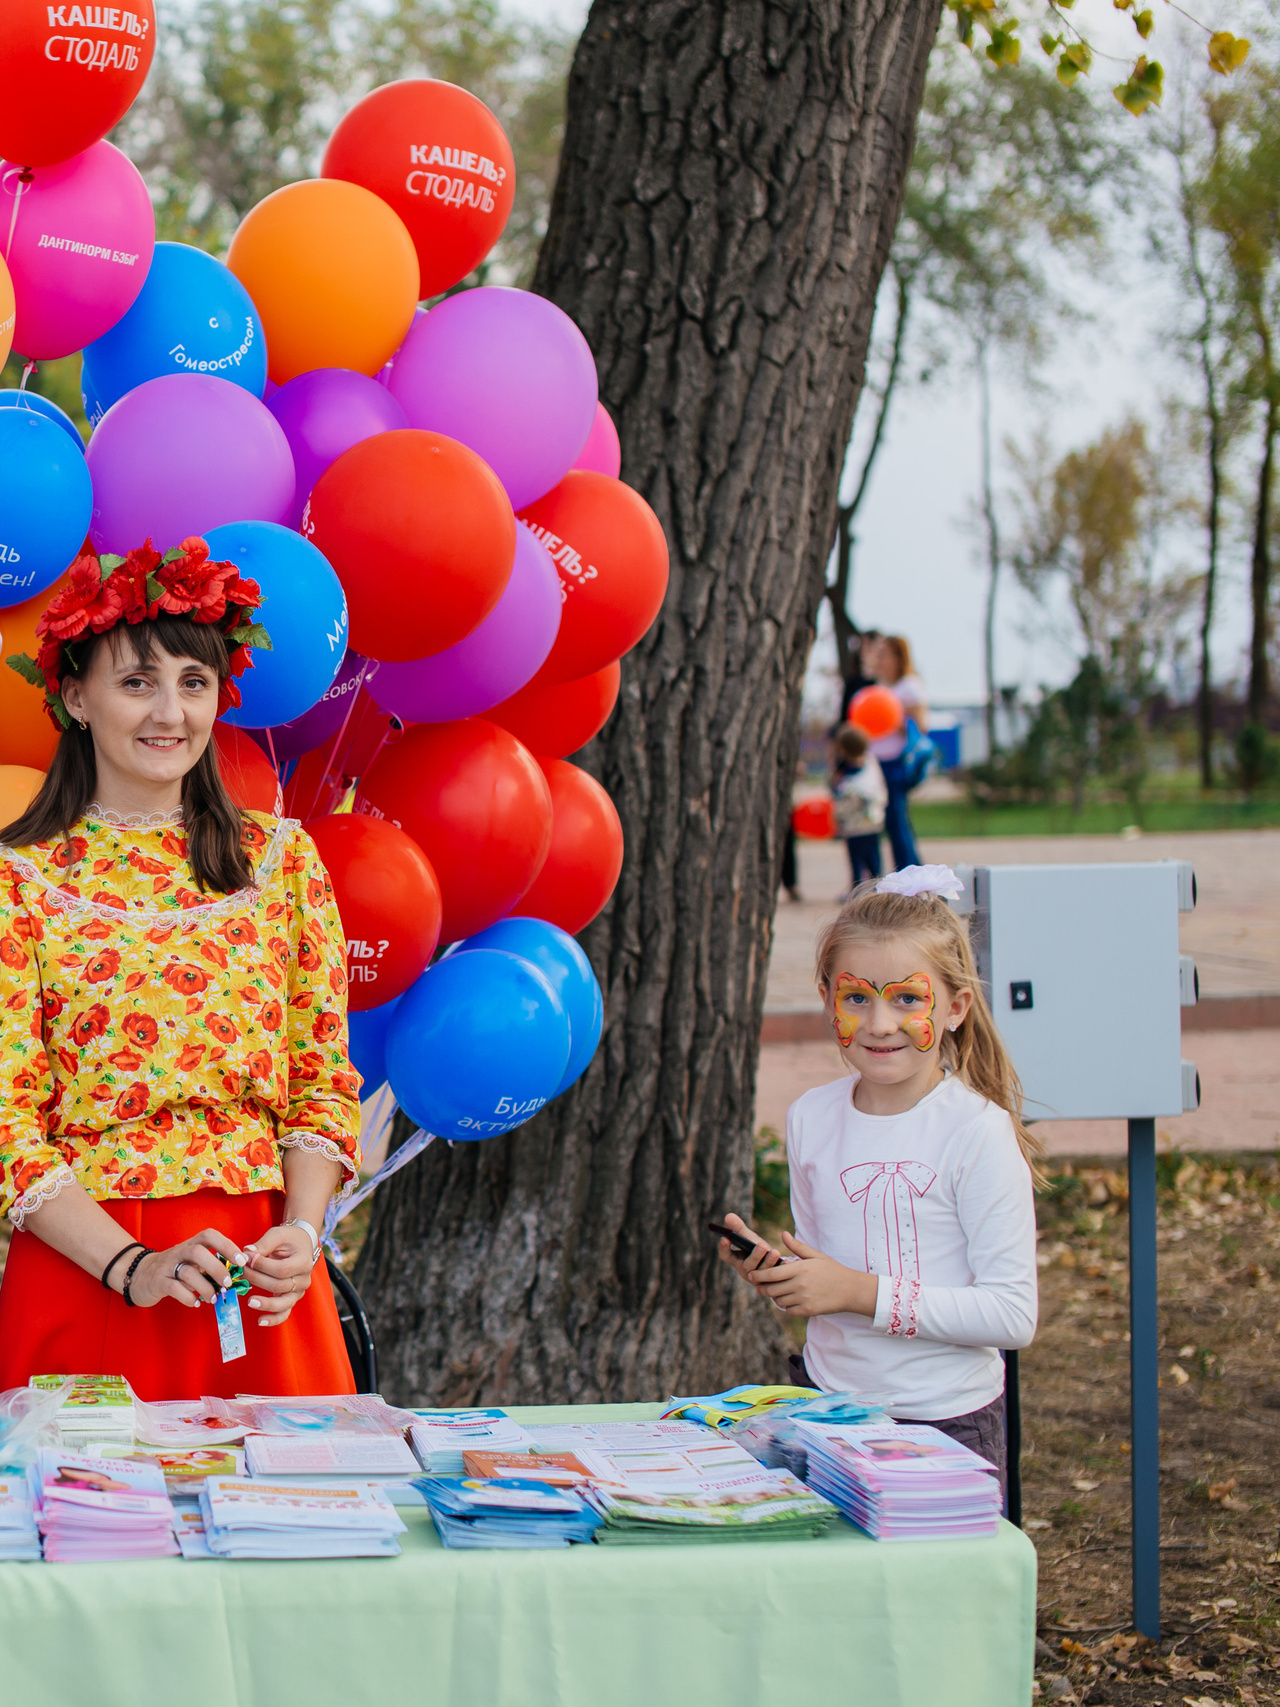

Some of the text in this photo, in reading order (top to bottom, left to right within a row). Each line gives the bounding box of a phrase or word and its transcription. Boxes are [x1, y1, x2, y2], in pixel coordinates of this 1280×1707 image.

[47, 5, 149, 40] КАШЕЛЬ?
[410, 144, 507, 187] КАШЕЛЬ?
[38, 234, 111, 260] ДАНТИНОРМ
[168, 316, 254, 371] Гомеостресом
[494, 1096, 547, 1120] Будь
